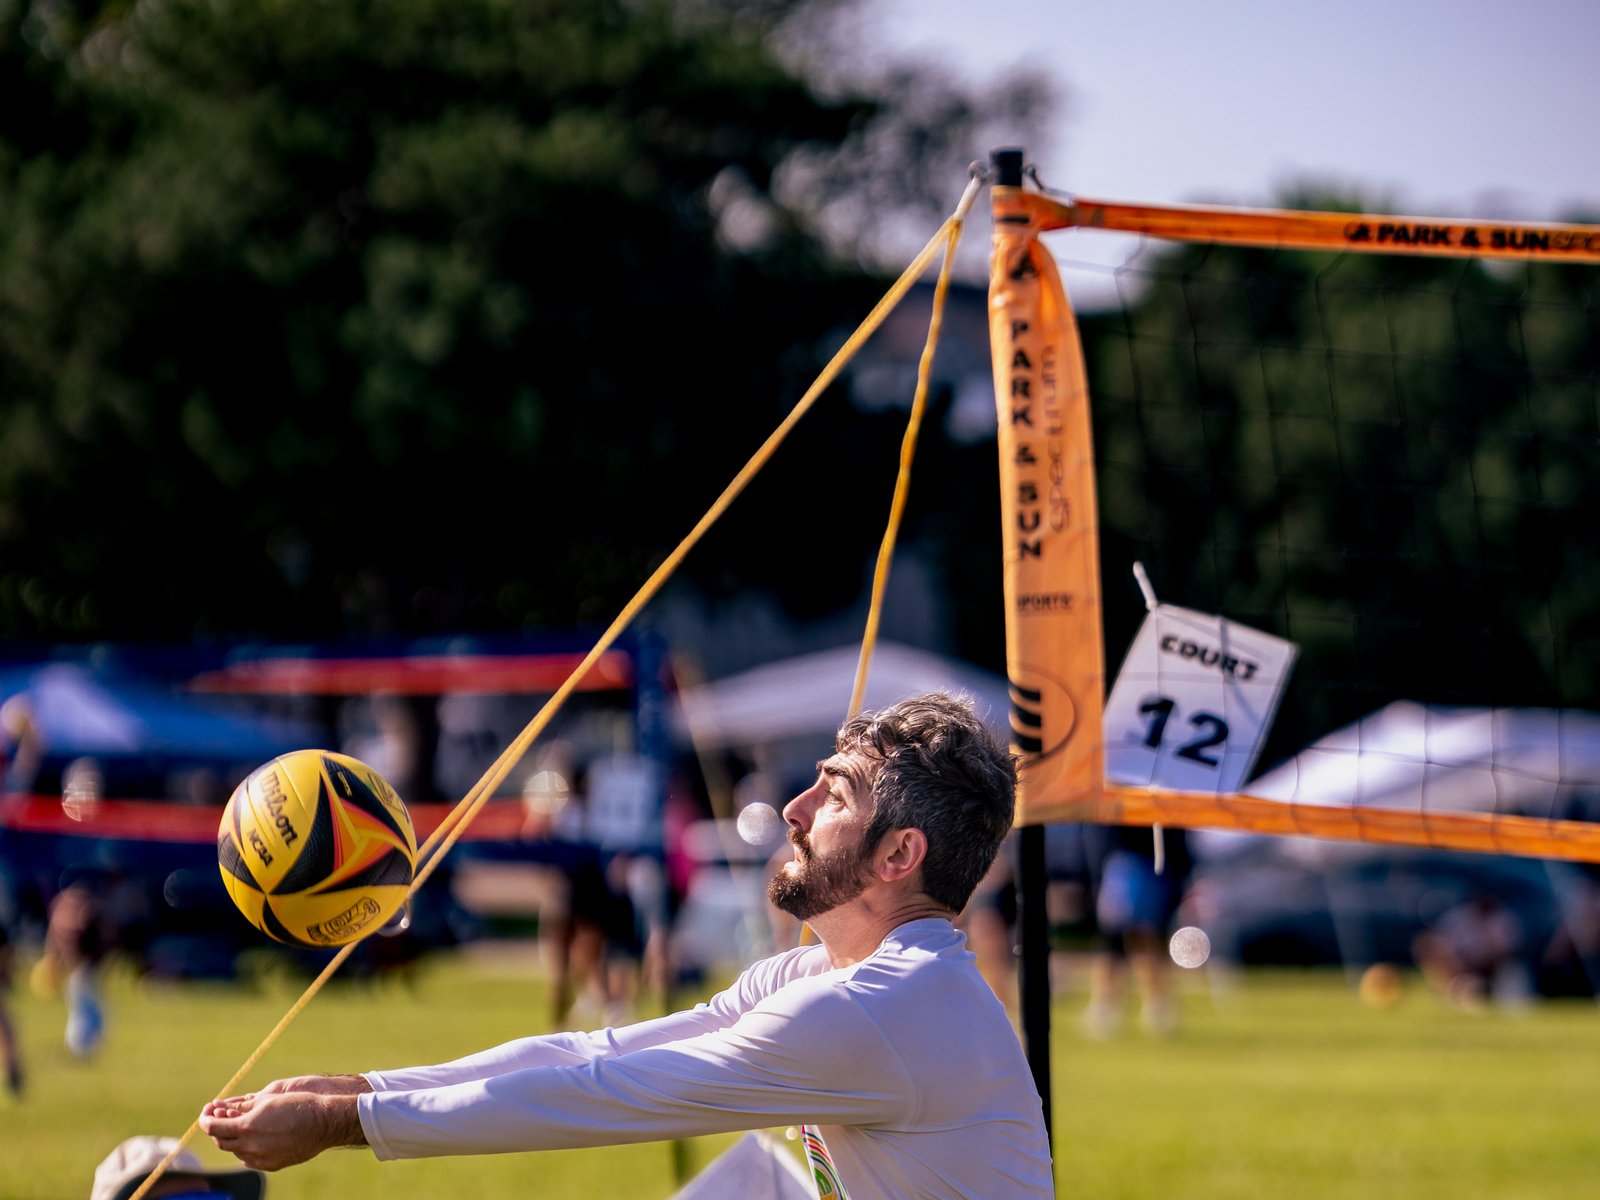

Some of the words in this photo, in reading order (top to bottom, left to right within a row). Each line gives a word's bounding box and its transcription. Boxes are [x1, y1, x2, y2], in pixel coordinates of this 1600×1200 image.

[1377, 222, 1451, 246] PARK
[1461, 226, 1481, 249] &
[1490, 228, 1550, 250] SUN
[1011, 319, 1033, 427] PARK
[1160, 635, 1260, 681] COURT
[1138, 694, 1229, 768] 12
[261, 771, 298, 848] Wilson
[247, 828, 274, 867] NCAA
